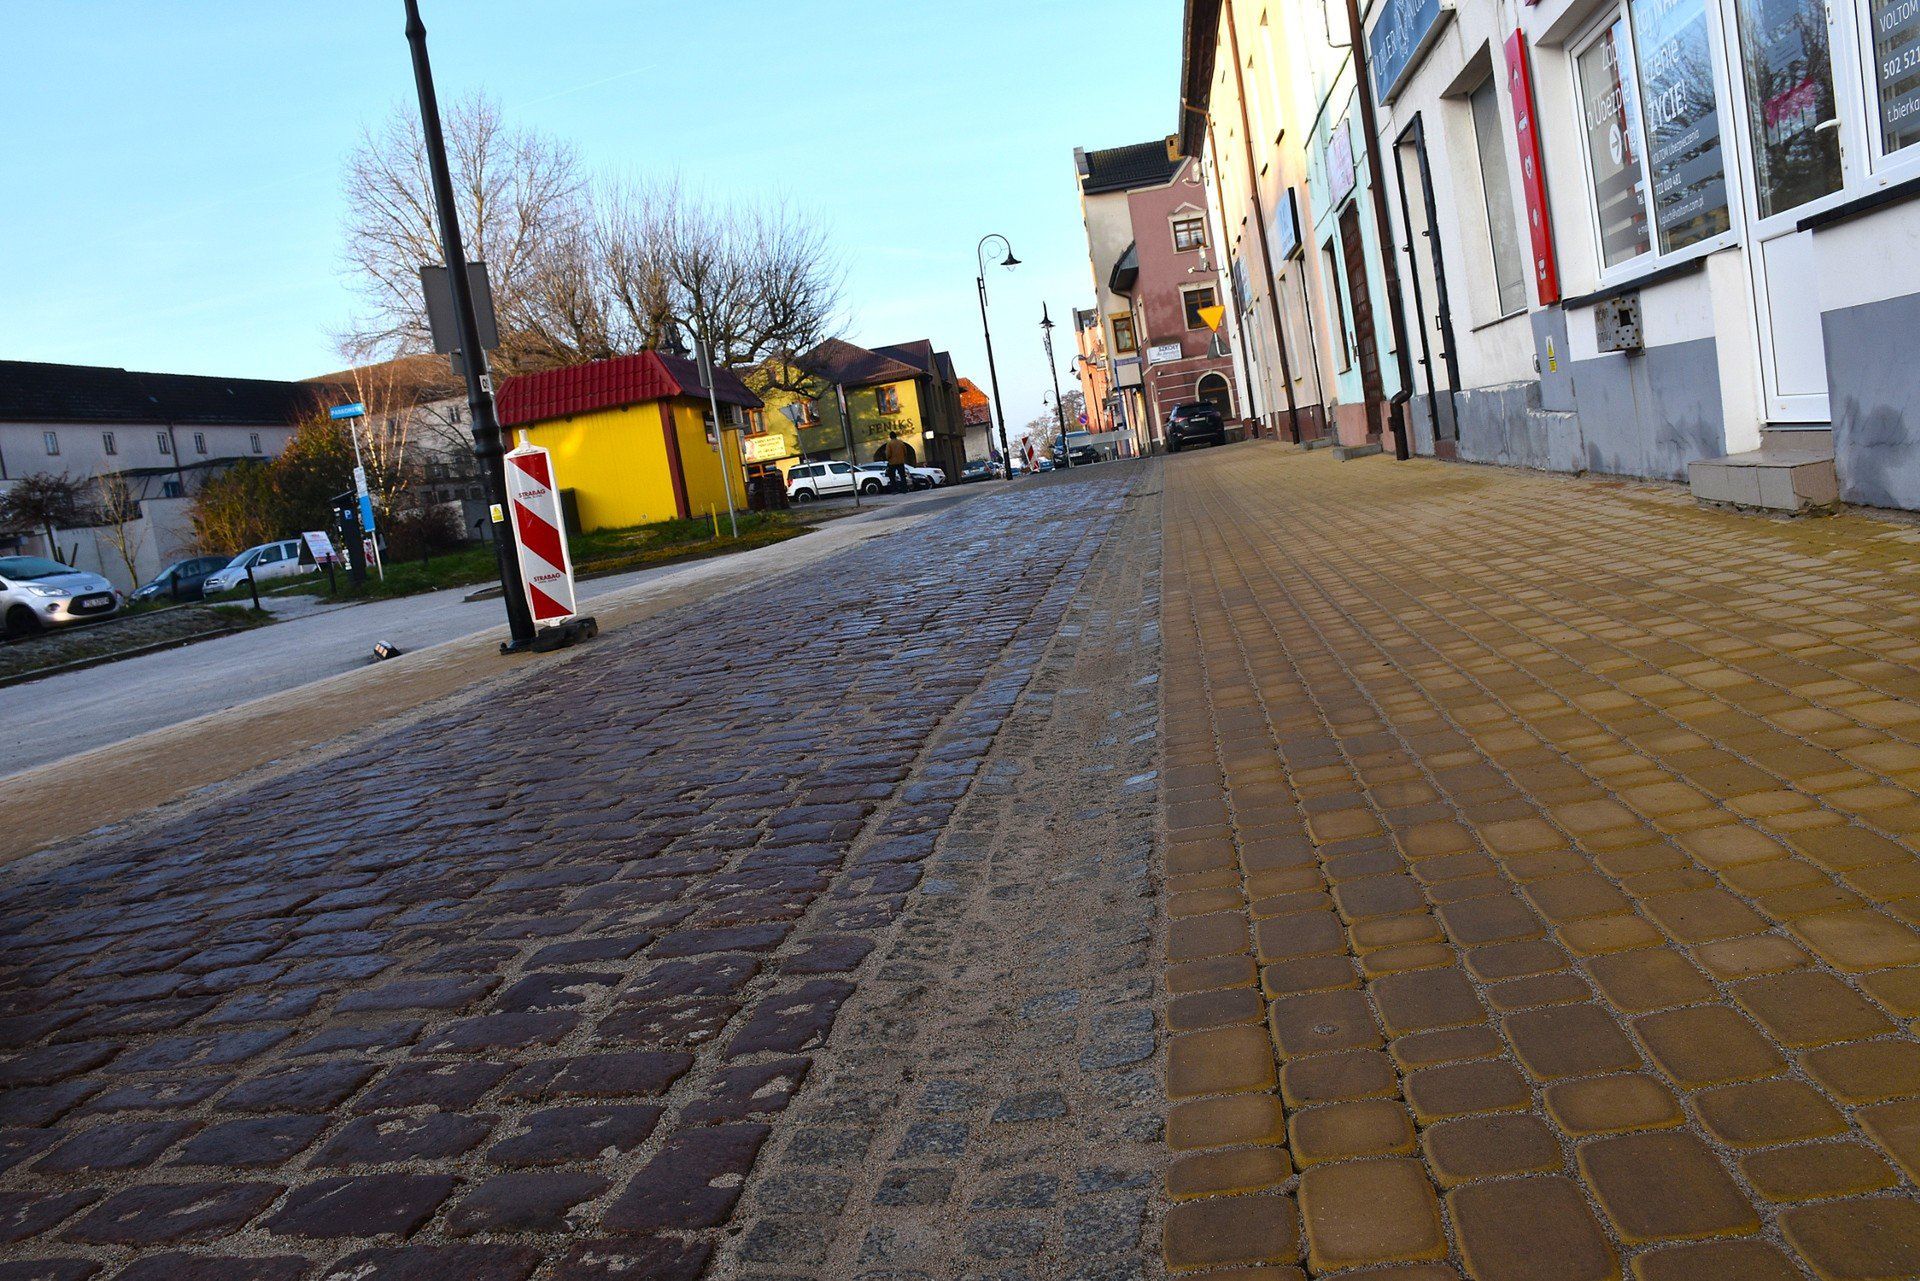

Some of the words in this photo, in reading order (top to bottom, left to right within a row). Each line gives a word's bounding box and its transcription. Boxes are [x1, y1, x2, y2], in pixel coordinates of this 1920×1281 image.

[1879, 0, 1919, 32] VOLTOM
[1883, 56, 1902, 80] 502
[868, 417, 914, 435] FENIKS
[518, 488, 546, 499] STRABAG
[344, 509, 353, 520] P
[533, 572, 560, 583] STRABAG
